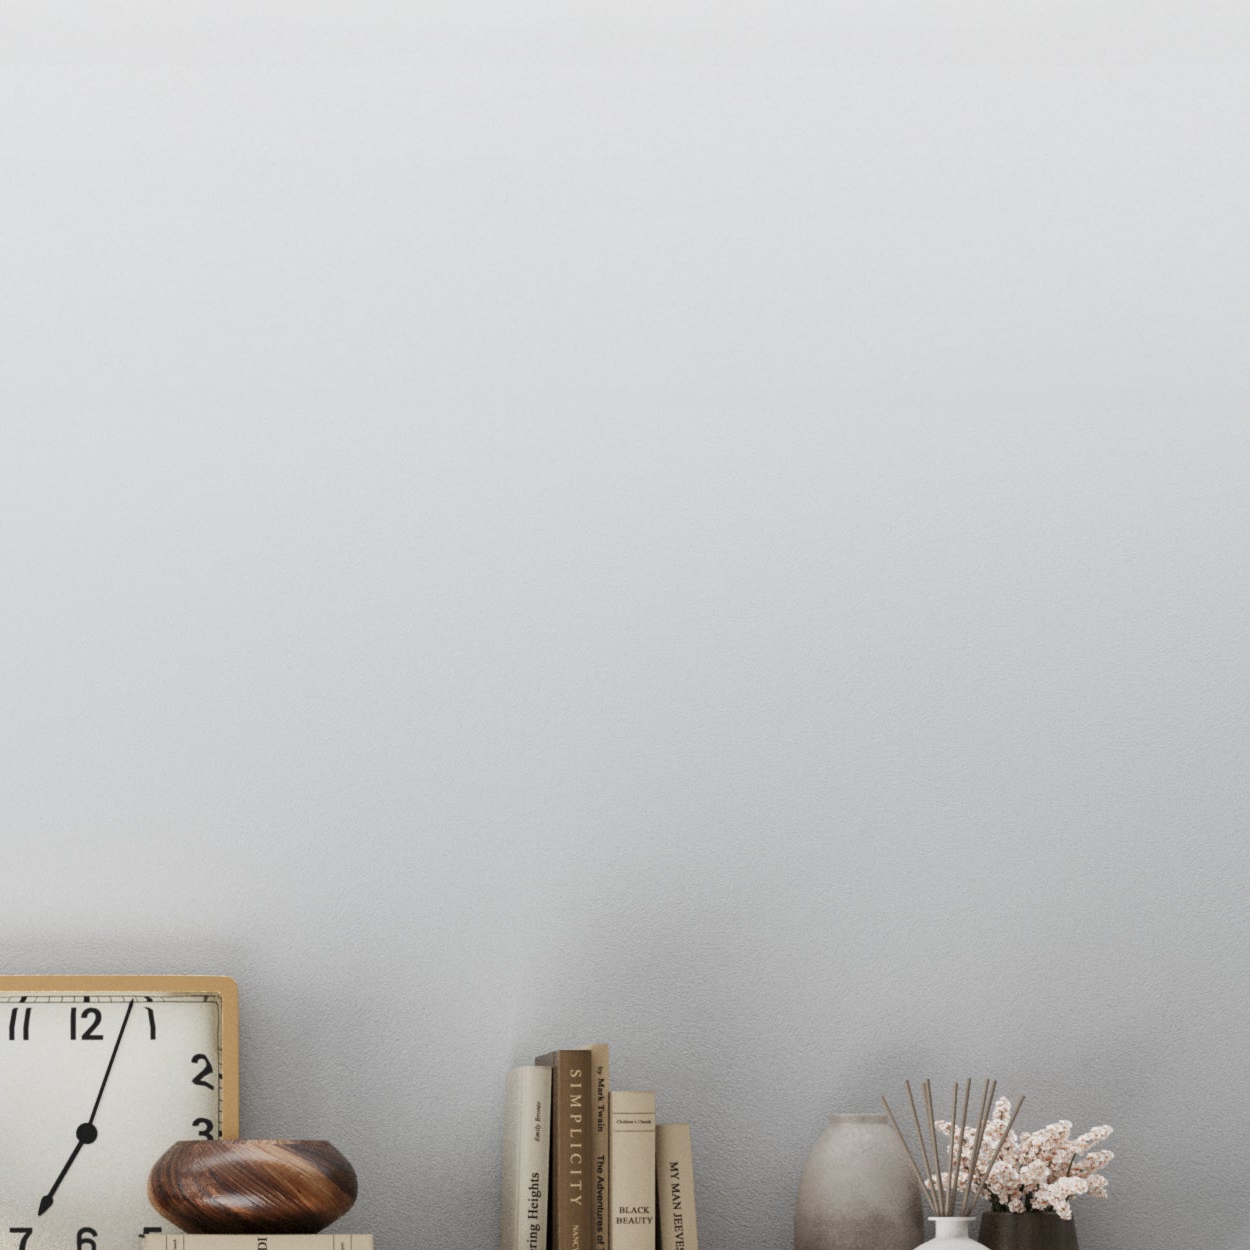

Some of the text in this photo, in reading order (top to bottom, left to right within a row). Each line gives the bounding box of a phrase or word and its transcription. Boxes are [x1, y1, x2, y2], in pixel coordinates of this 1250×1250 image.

[8, 1007, 32, 1041] 11
[70, 1007, 103, 1040] 12
[145, 1006, 156, 1040] 1
[191, 1053, 214, 1090] 2
[596, 1066, 605, 1132] by Mark Twain
[191, 1117, 214, 1140] 3
[533, 1123, 542, 1142] Emily
[570, 1069, 582, 1206] SIMPLICITY
[597, 1155, 605, 1174] The
[669, 1162, 680, 1180] MY
[527, 1172, 542, 1220] Heights
[596, 1175, 605, 1233] Adventures
[619, 1206, 650, 1214] BLACK
[671, 1183, 681, 1210] MAN
[616, 1216, 653, 1225] BEAUTY
[597, 1235, 605, 1245] of
